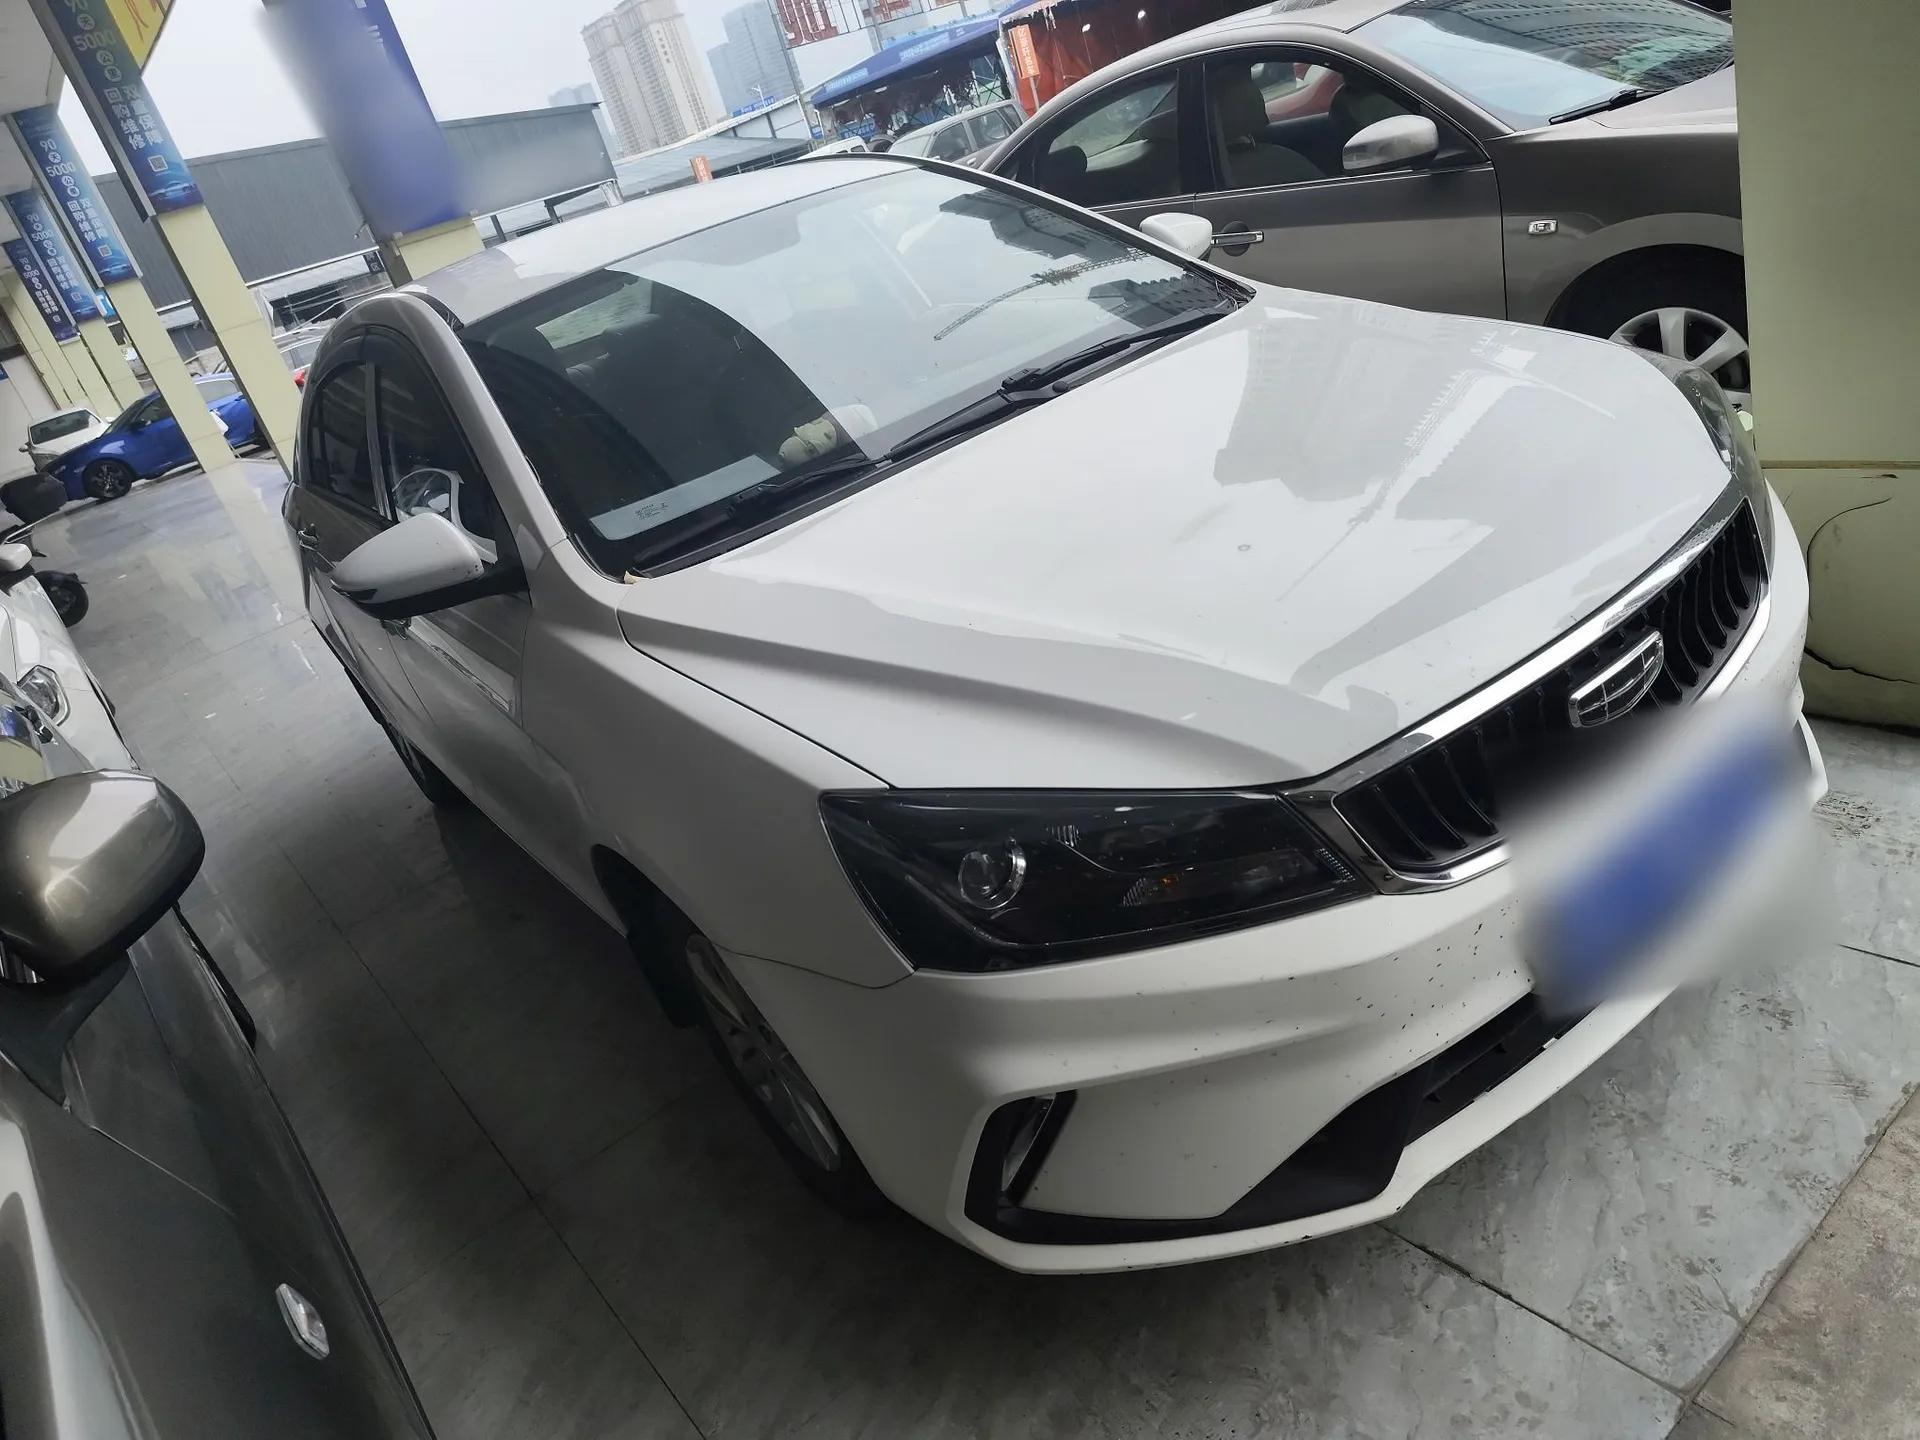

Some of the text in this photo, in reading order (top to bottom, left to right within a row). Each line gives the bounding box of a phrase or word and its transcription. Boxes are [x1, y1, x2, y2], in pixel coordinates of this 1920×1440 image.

[73, 31, 117, 51] 5000
[103, 87, 145, 150] 回购维修
[39, 138, 57, 152] 90
[45, 162, 76, 177] 5000
